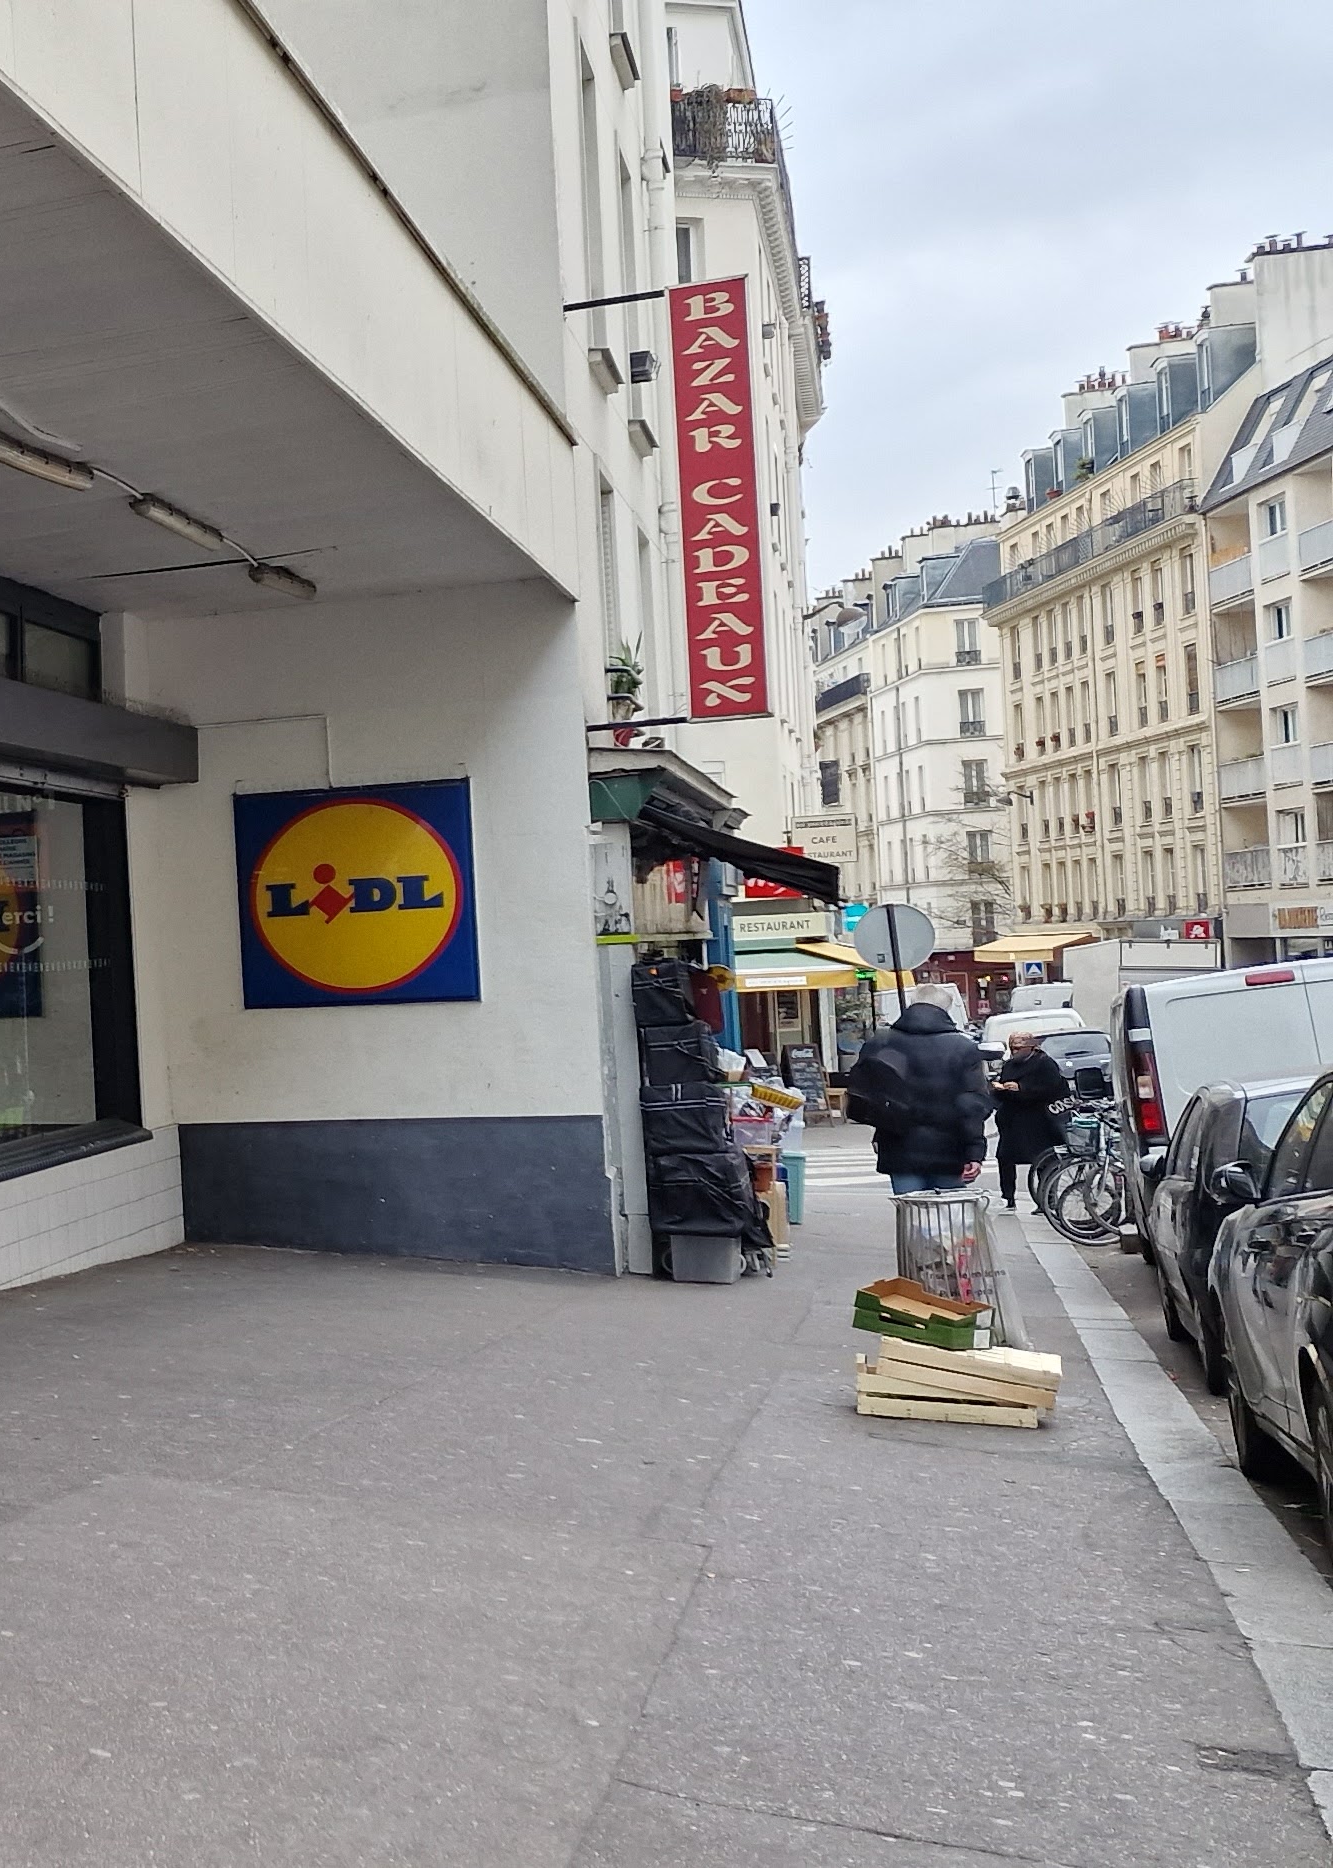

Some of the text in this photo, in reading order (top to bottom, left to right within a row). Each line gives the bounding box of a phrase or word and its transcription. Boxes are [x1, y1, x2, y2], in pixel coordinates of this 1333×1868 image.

[681, 291, 756, 707] BAZAR CADEAUX
[739, 920, 811, 933] RESTAURANT
